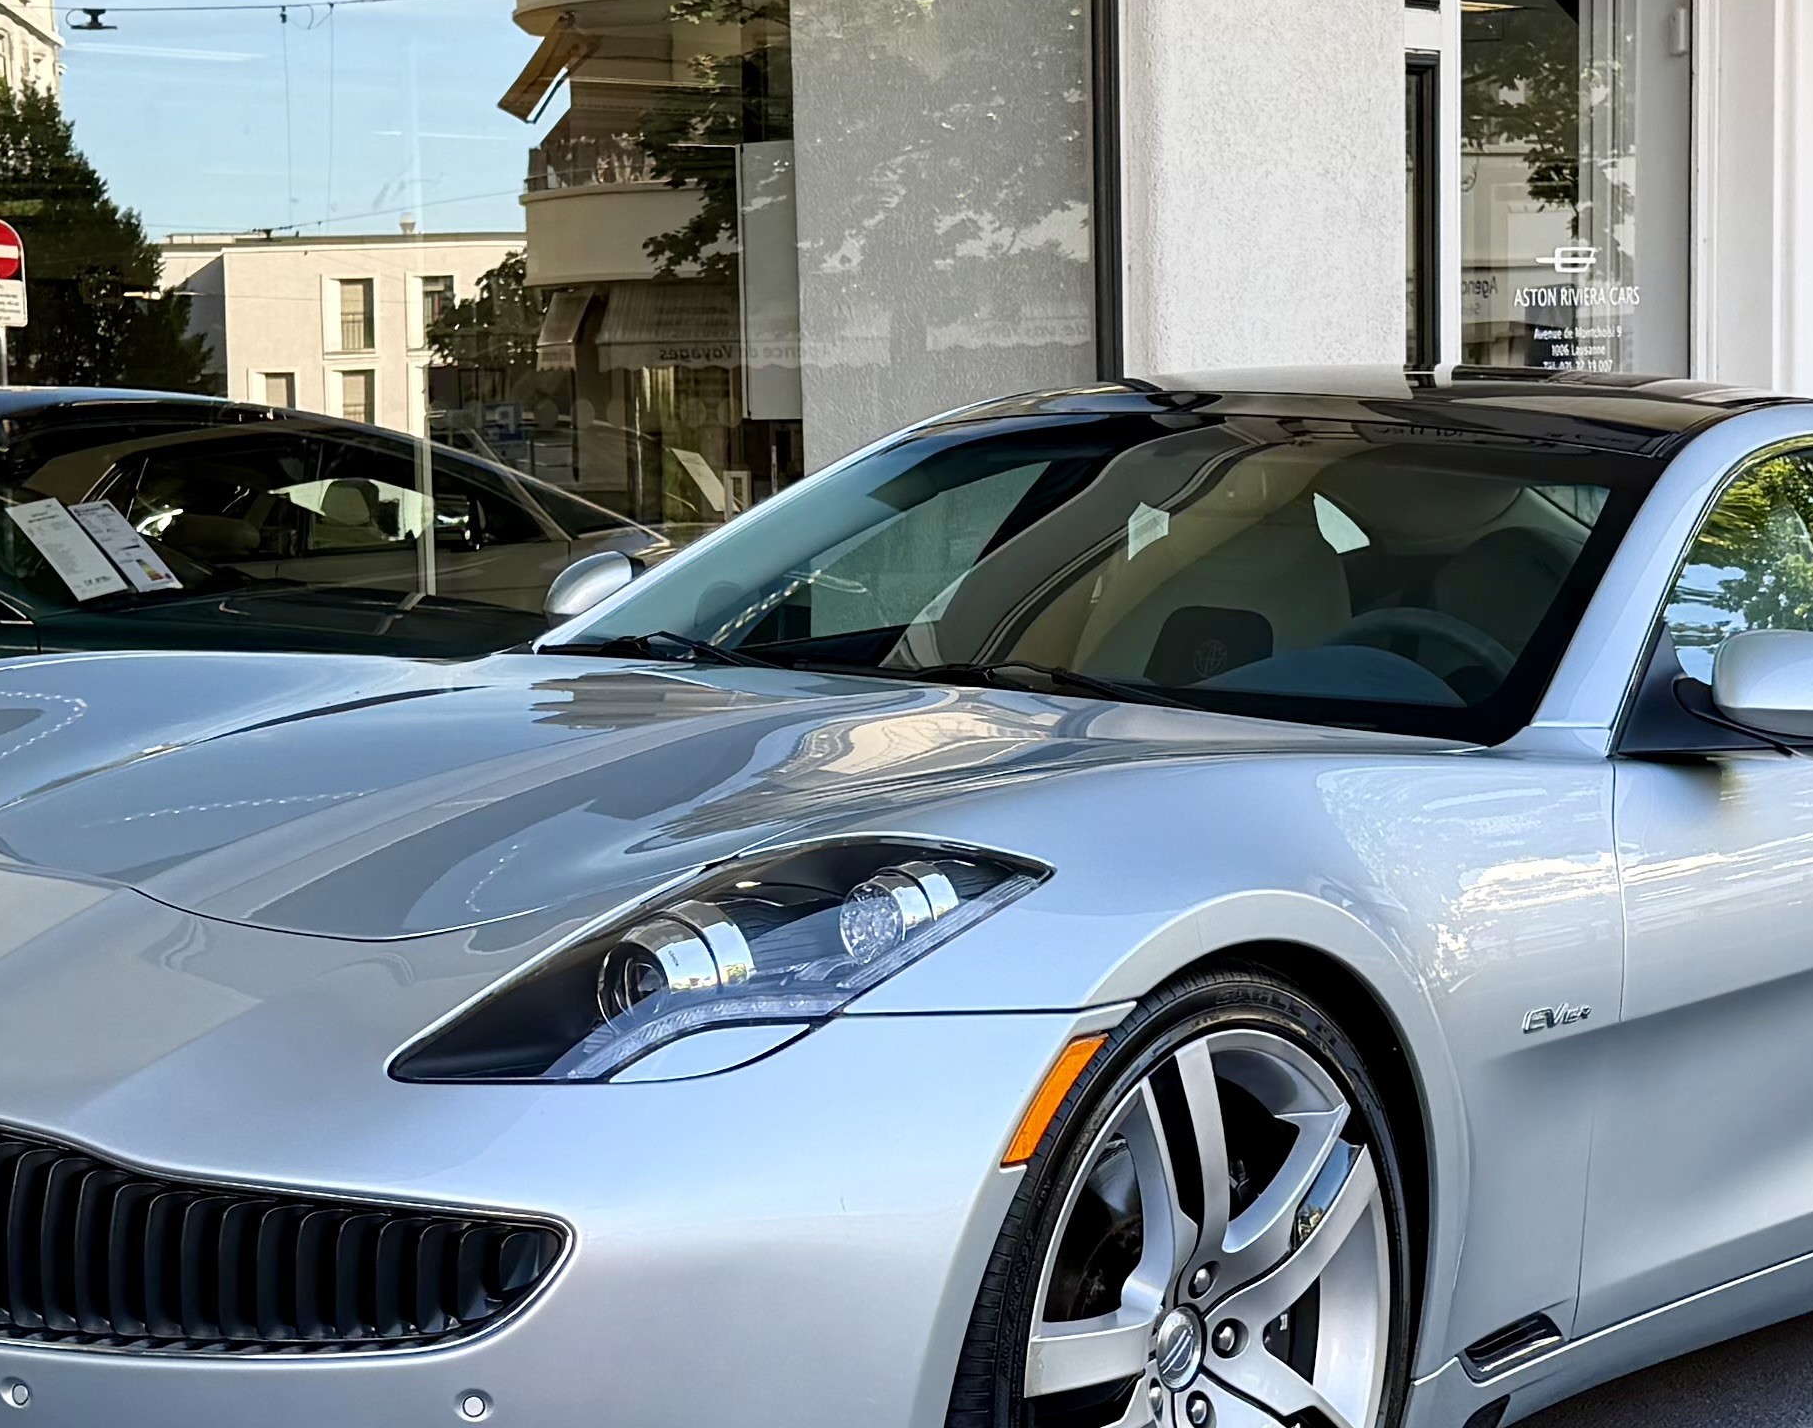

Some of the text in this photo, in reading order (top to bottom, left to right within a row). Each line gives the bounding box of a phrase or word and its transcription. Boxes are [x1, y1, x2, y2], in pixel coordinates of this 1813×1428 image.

[1514, 286, 1640, 307] ASTON RIVIERA CARS
